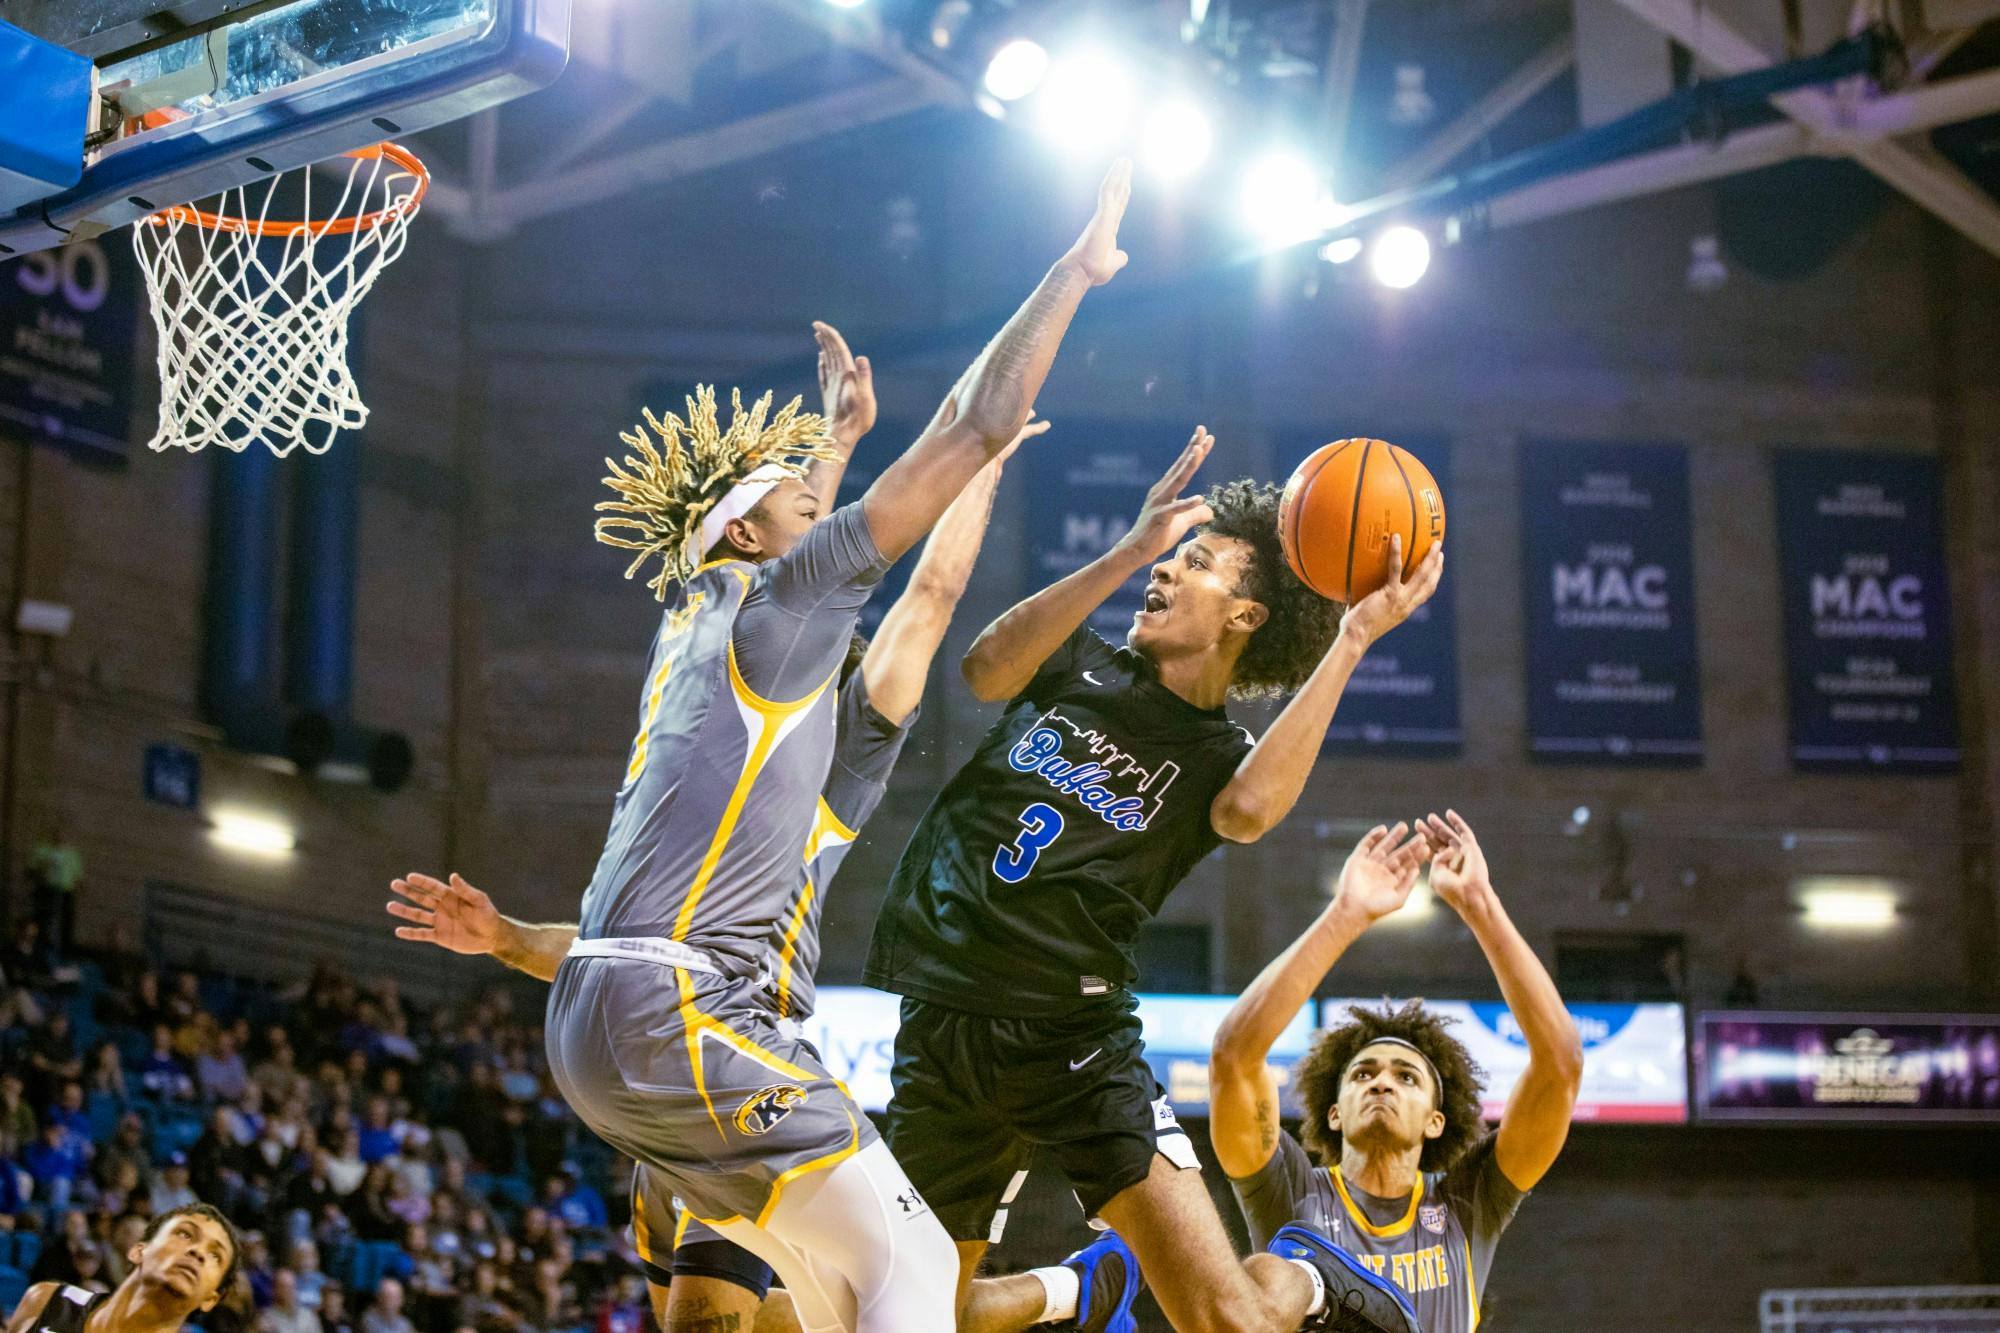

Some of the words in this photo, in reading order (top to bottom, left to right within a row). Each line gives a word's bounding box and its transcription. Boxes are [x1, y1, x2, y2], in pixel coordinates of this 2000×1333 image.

[1554, 564, 1669, 607] MAC
[1811, 574, 1922, 619] MAC
[1008, 727, 1148, 832] Buffalo
[992, 802, 1065, 884] 3
[1391, 1244, 1449, 1293] STATE
